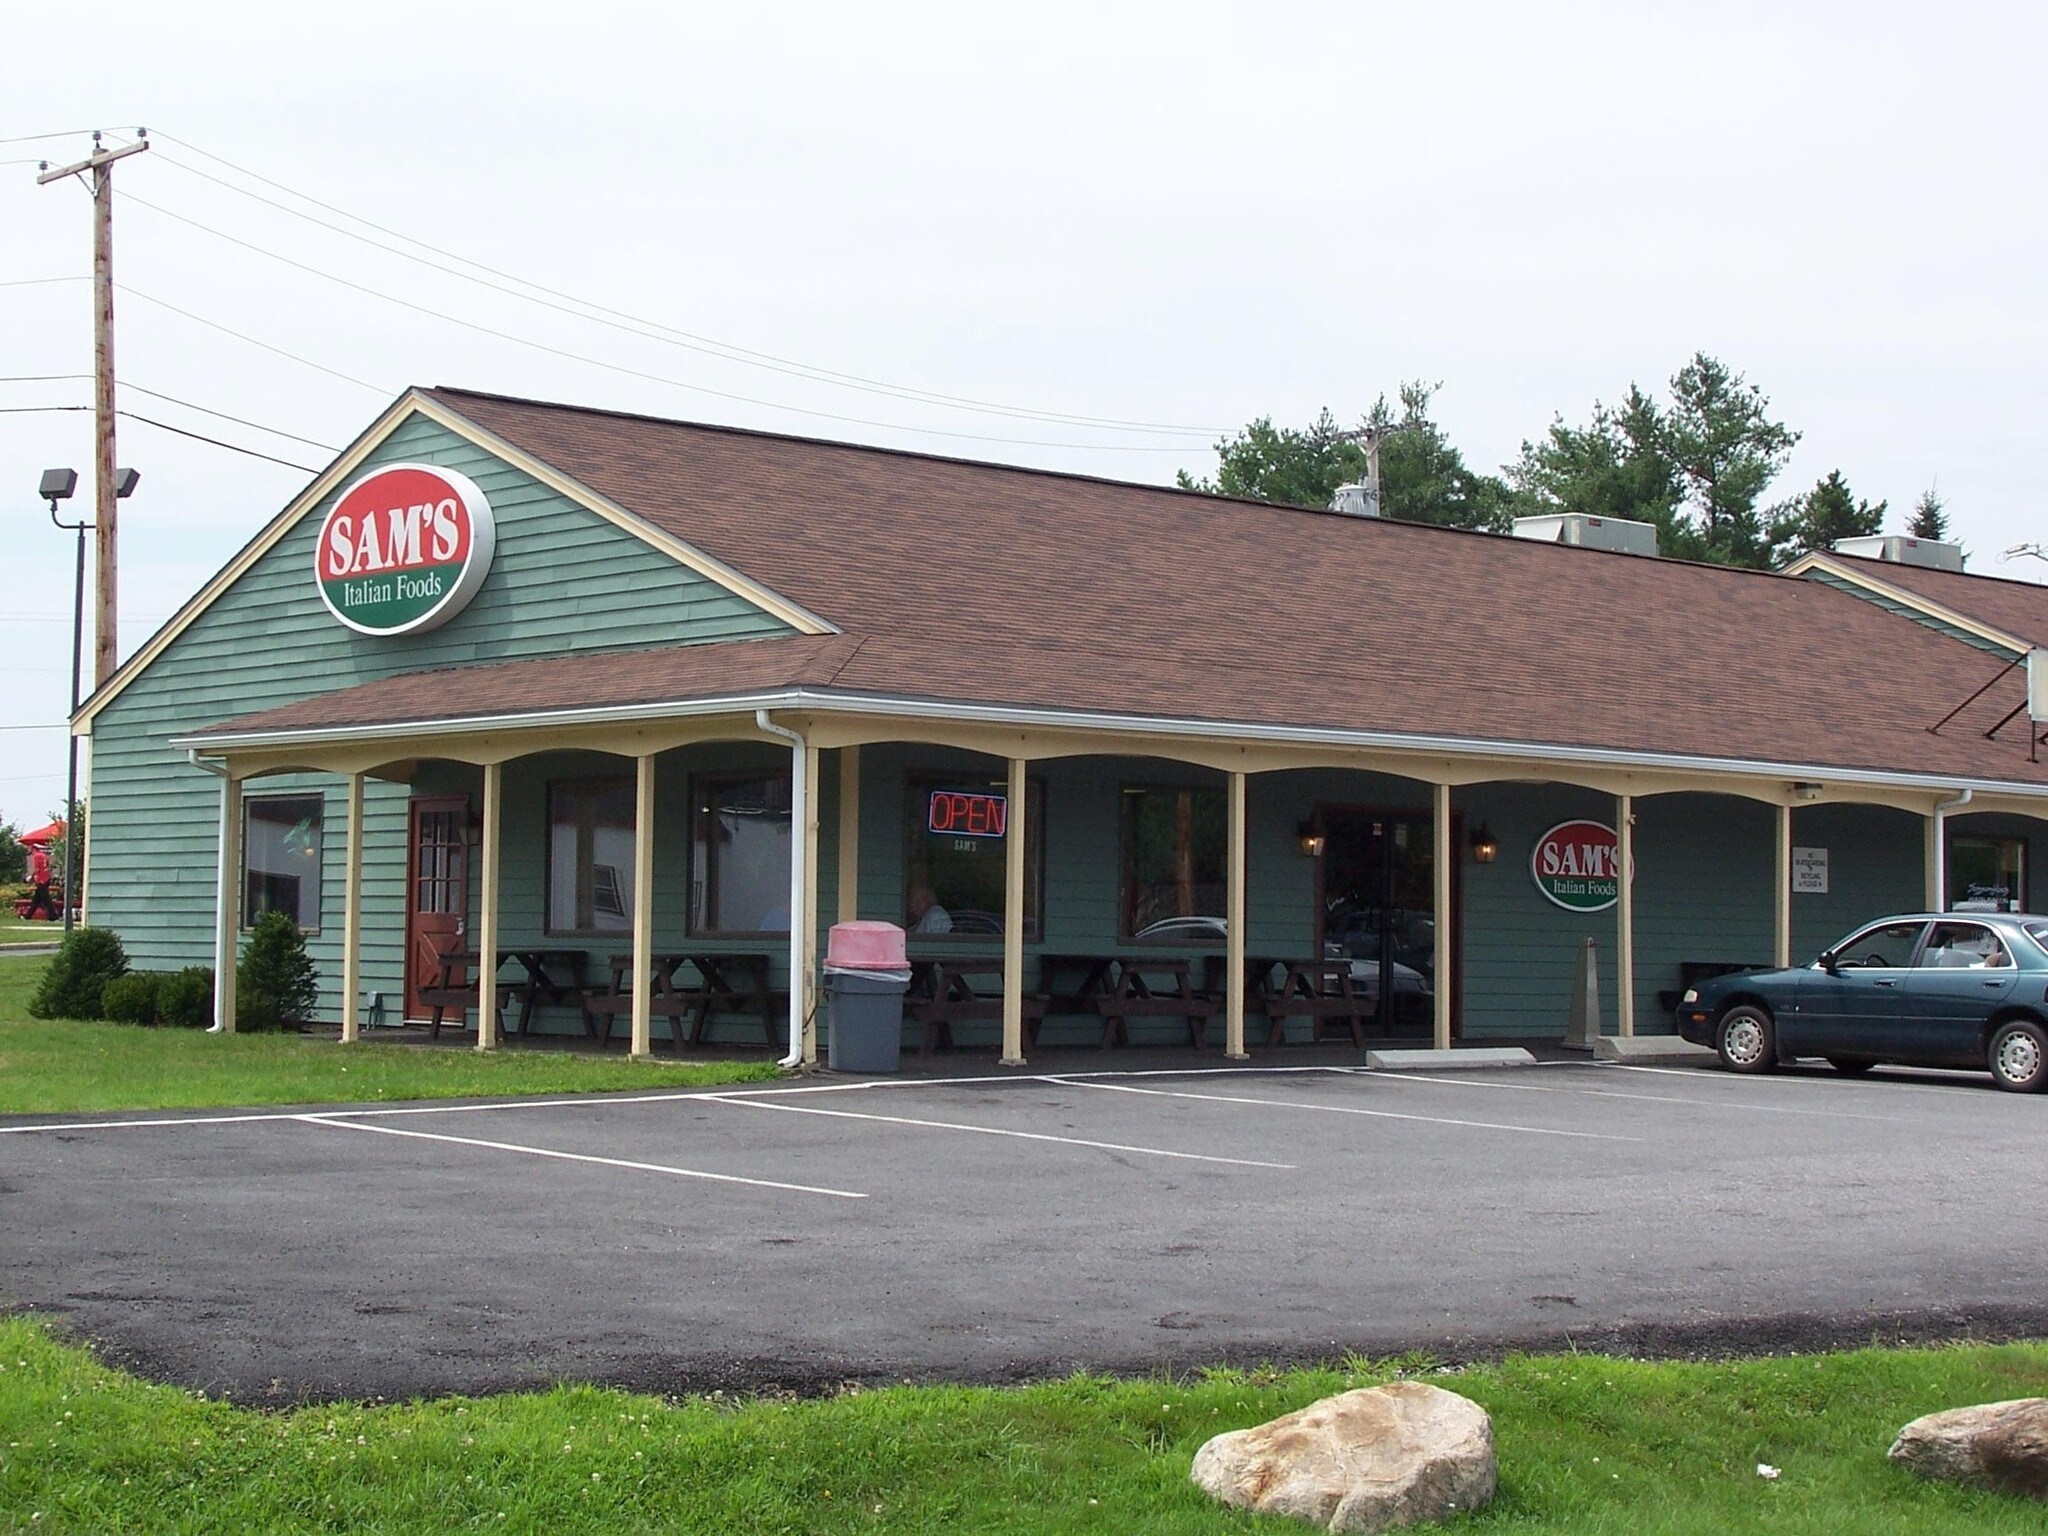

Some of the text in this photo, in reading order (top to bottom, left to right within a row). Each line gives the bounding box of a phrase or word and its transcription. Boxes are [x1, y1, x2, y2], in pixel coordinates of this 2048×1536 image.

[329, 498, 460, 576] SAM'S
[344, 572, 442, 607] Italian Foods
[932, 794, 1004, 835] OPEN
[1553, 880, 1616, 895] Italian Foods
